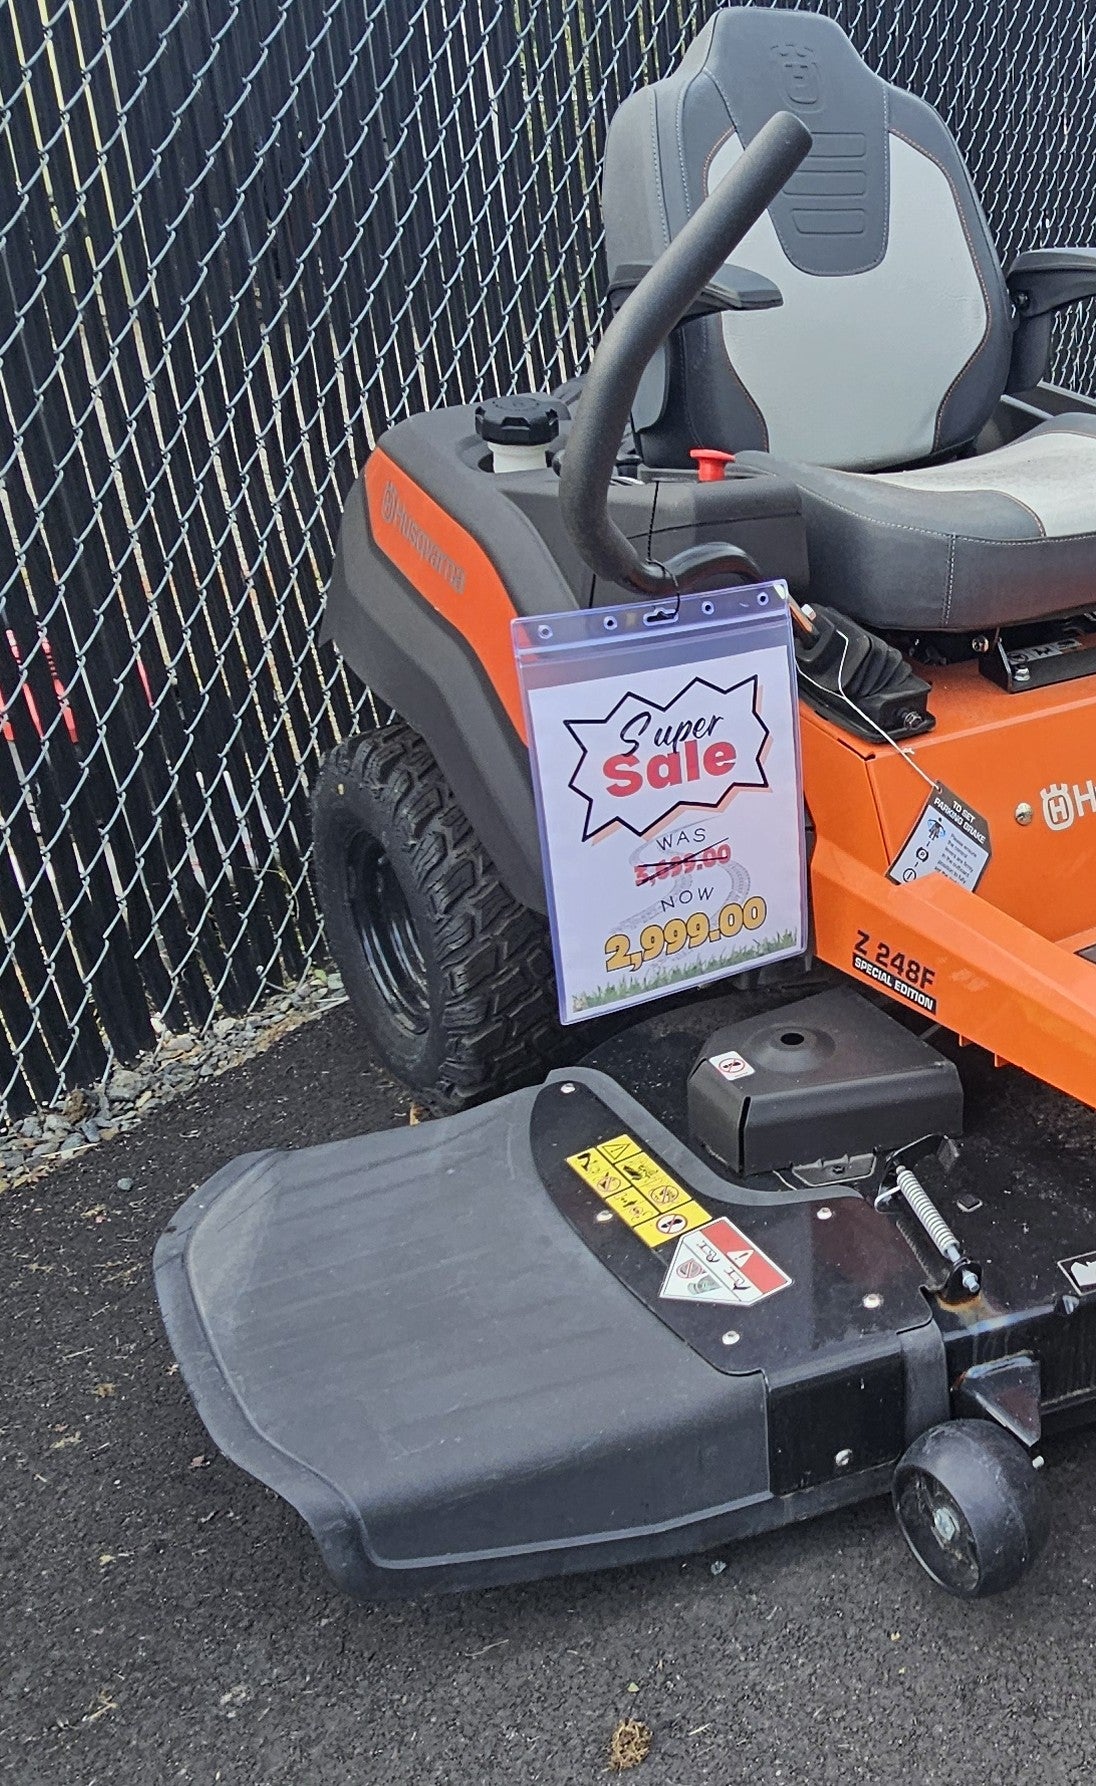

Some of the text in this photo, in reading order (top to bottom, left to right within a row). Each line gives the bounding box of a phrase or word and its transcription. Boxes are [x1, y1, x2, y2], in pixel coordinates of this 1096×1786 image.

[393, 502, 467, 595] Husqvarna
[620, 711, 724, 757] Super
[602, 739, 737, 797] Sale
[934, 797, 986, 844] PARKING BRAKE
[952, 800, 975, 823] TO SET
[656, 828, 706, 850] WAS
[661, 887, 714, 912] NOW
[604, 896, 768, 973] 2,999.00
[854, 929, 936, 989] Z 248F
[855, 957, 934, 1010] SPECIAL EDITION
